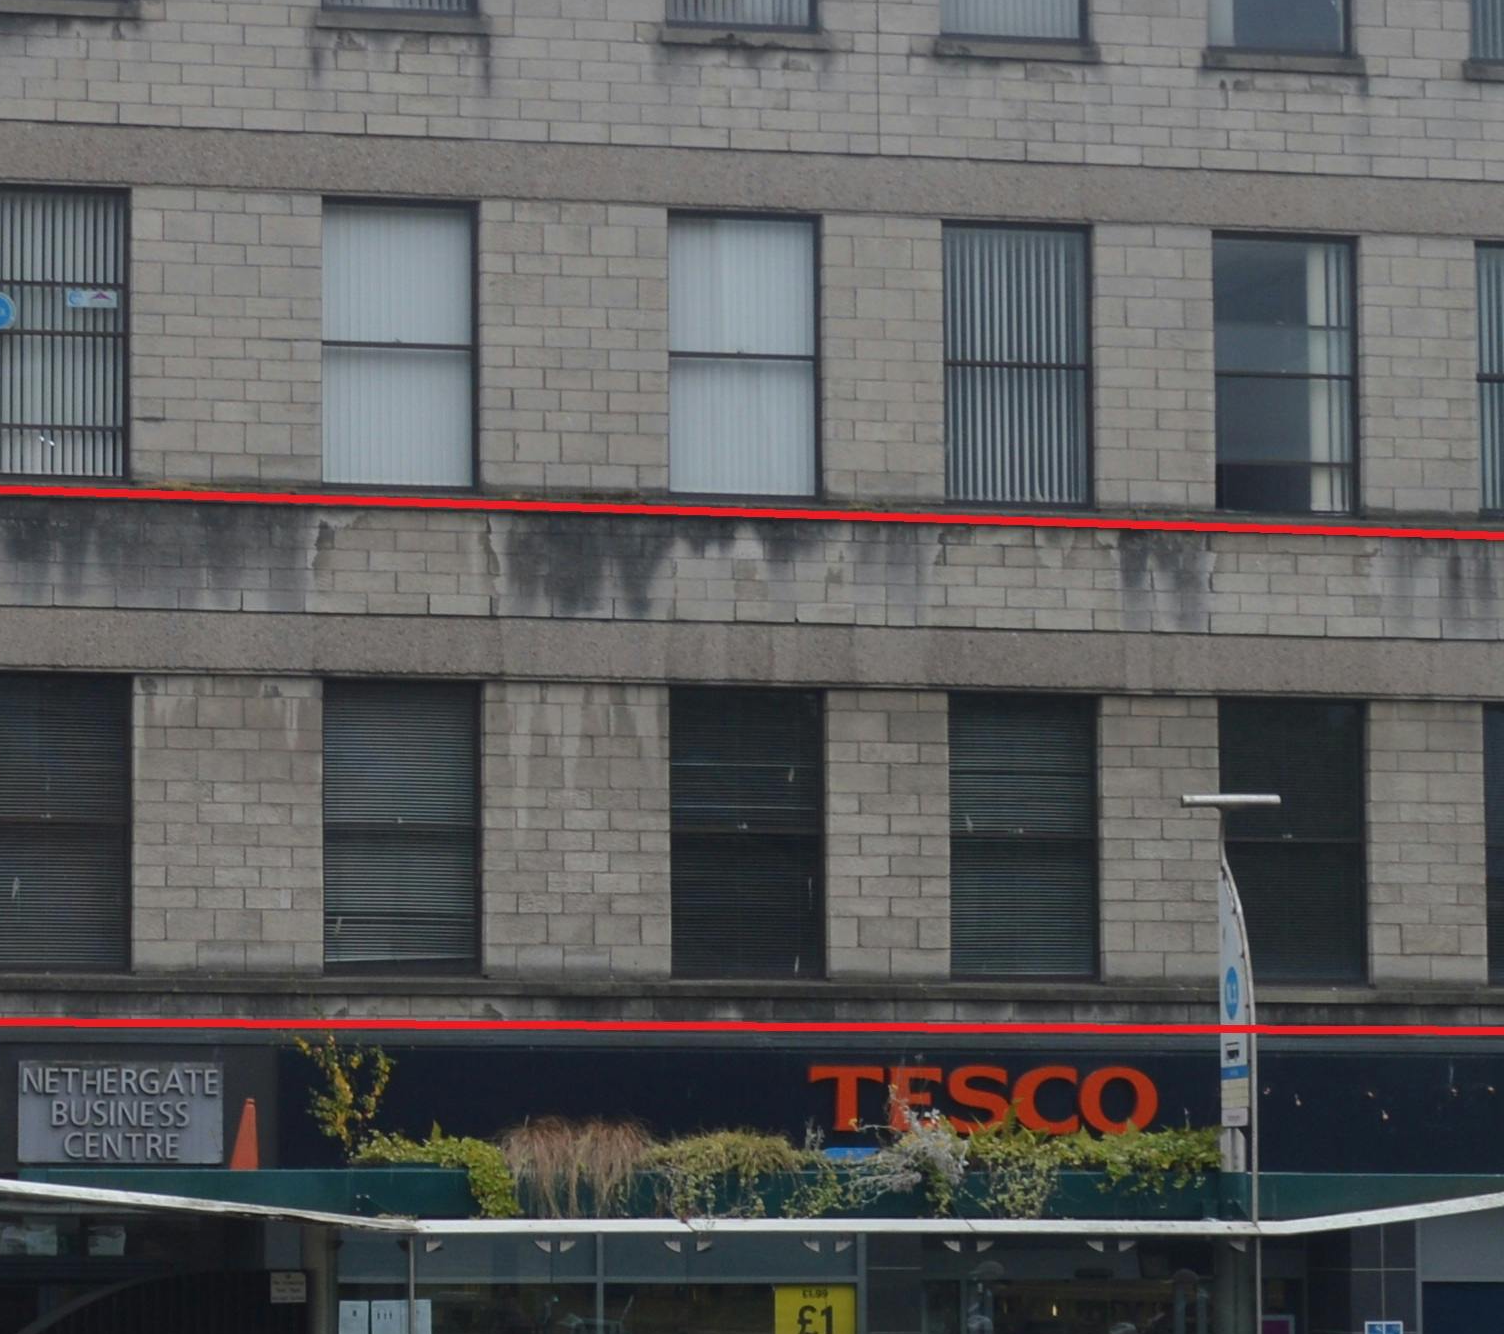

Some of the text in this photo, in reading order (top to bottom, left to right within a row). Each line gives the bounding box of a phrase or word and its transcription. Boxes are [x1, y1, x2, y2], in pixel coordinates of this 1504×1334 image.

[22, 1067, 219, 1095] NETHERGATE
[808, 1063, 1158, 1135] TESCO
[51, 1100, 190, 1127] BUSINESS
[64, 1132, 180, 1160] CENTRE
